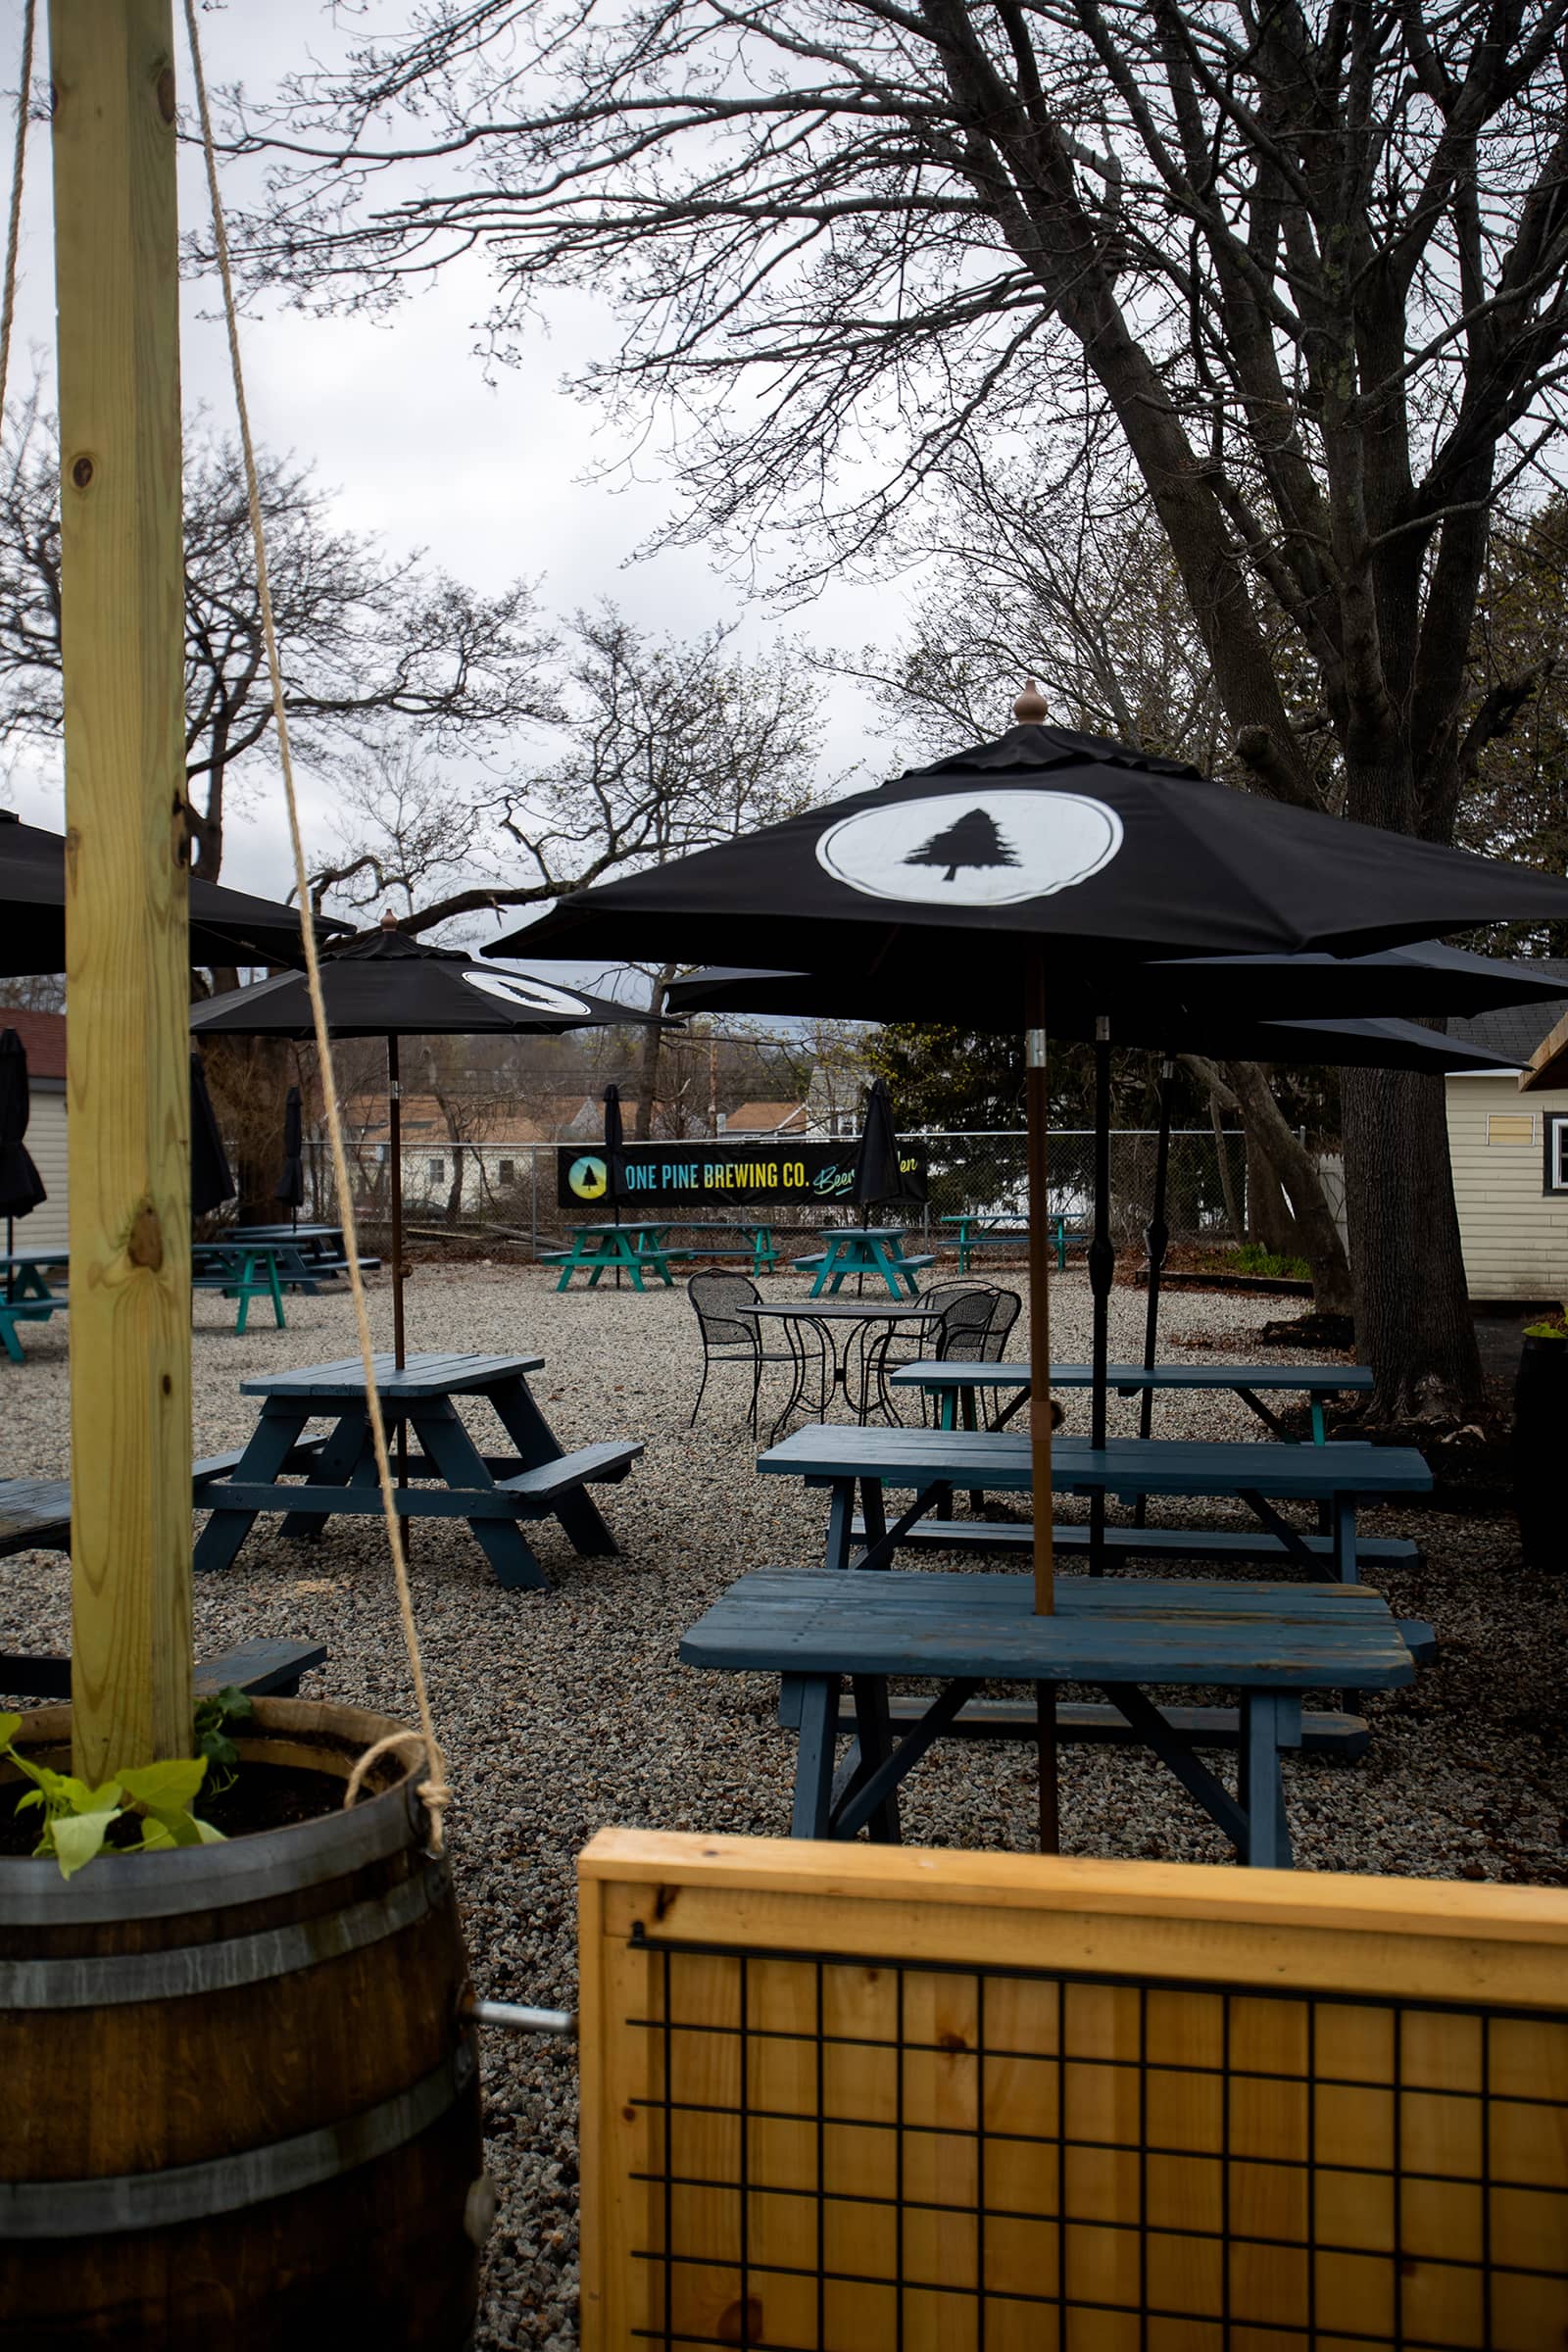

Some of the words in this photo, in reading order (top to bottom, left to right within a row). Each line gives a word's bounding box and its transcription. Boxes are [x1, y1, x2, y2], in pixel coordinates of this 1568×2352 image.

[625, 1164, 657, 1190] ONE
[662, 1163, 699, 1189] PINE
[704, 1162, 776, 1189] BREWING
[782, 1161, 809, 1188] CO.
[812, 1164, 856, 1195] Beer
